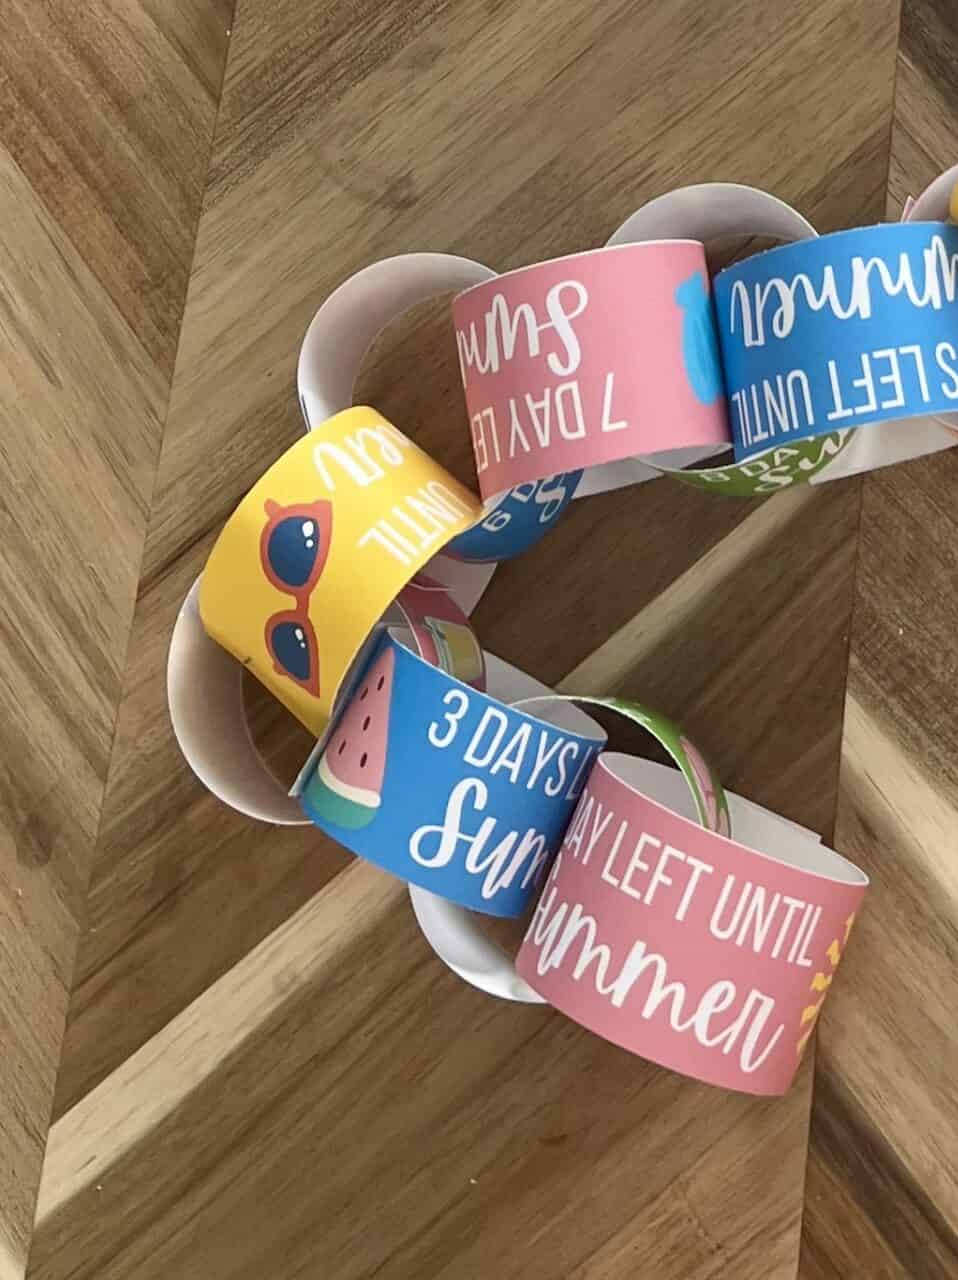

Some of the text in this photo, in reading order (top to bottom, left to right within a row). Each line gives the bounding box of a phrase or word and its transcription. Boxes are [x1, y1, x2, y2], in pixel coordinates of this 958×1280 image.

[455, 279, 589, 389] Sum
[509, 380, 587, 459] DAY
[601, 371, 629, 433] 7
[731, 369, 815, 449] UNTIL
[826, 344, 931, 421] LEFT
[472, 407, 501, 474] LE
[356, 480, 476, 567] UNTIL
[427, 688, 470, 749] 3
[462, 705, 580, 798] DAYS
[408, 776, 550, 900] Sum
[600, 820, 714, 922] LEFT
[708, 874, 823, 968] UNTIL
